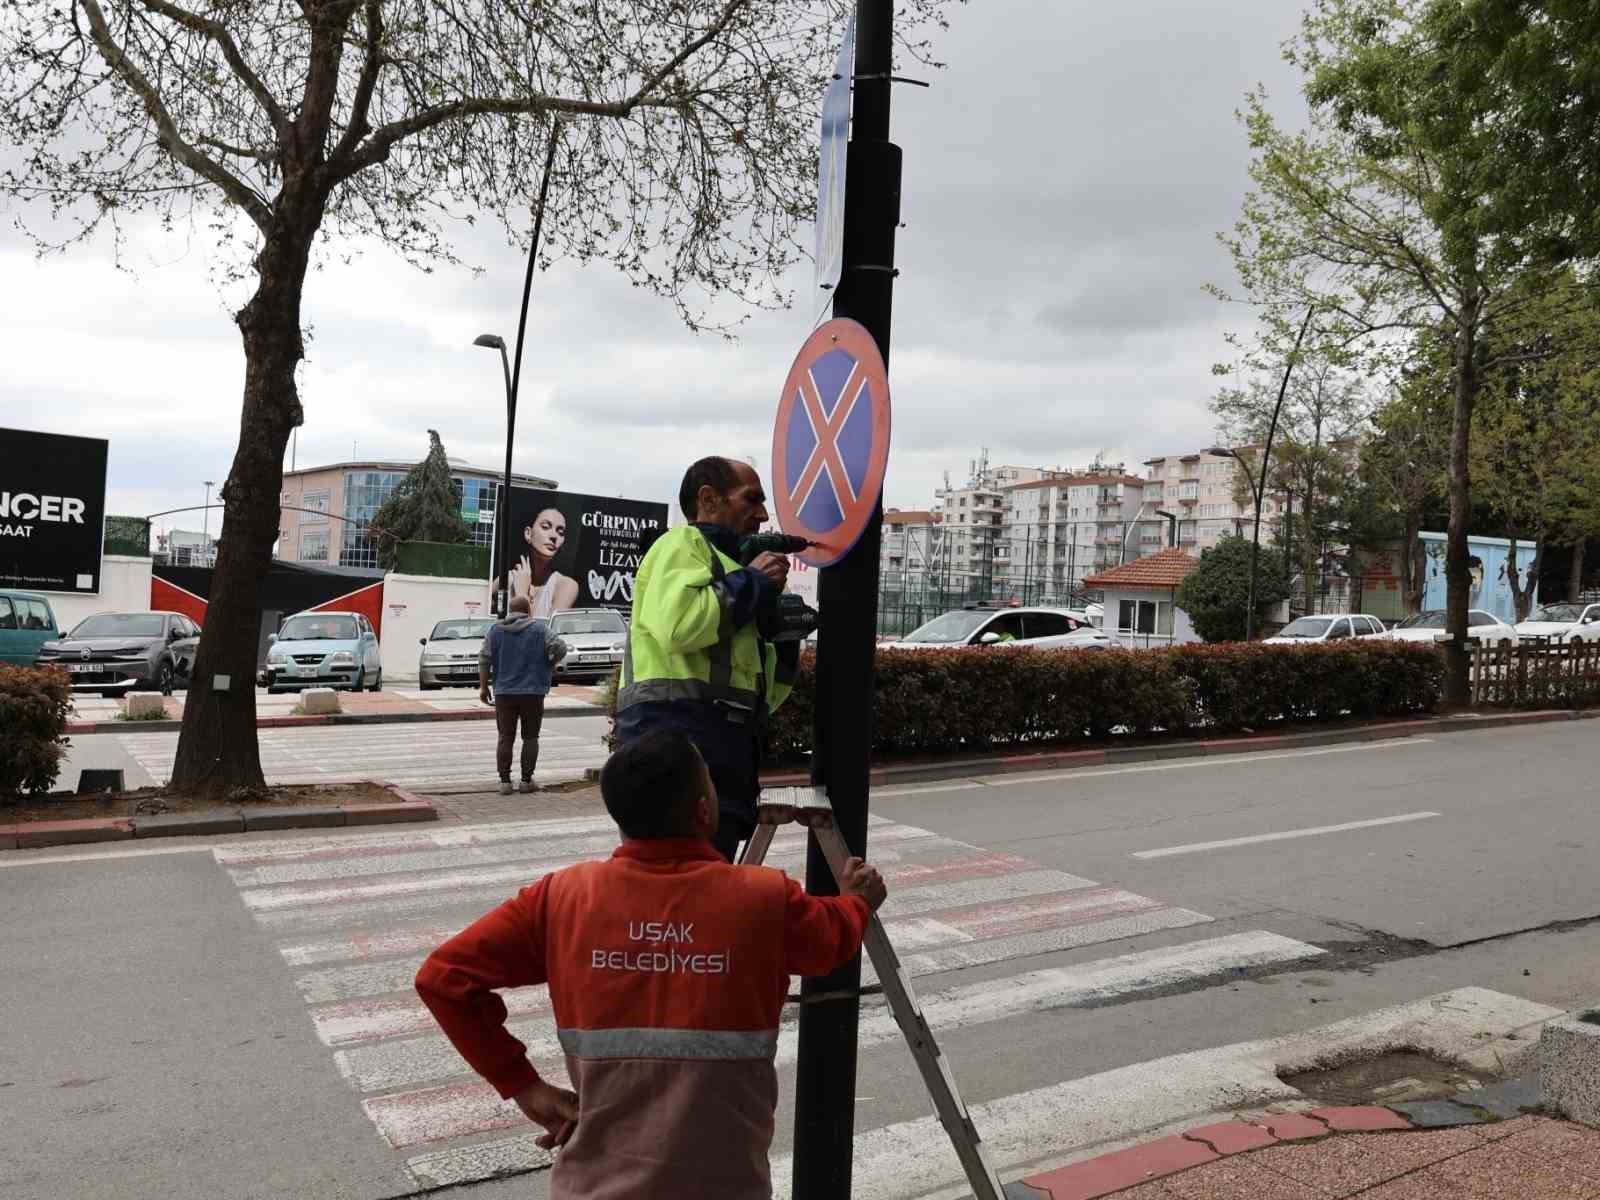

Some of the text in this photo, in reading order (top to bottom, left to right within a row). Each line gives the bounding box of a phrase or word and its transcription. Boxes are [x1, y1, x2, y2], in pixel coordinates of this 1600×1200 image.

[0, 523, 34, 537] AAT
[628, 921, 694, 946] UŞAK
[591, 949, 730, 974] BELEDİYESİ
